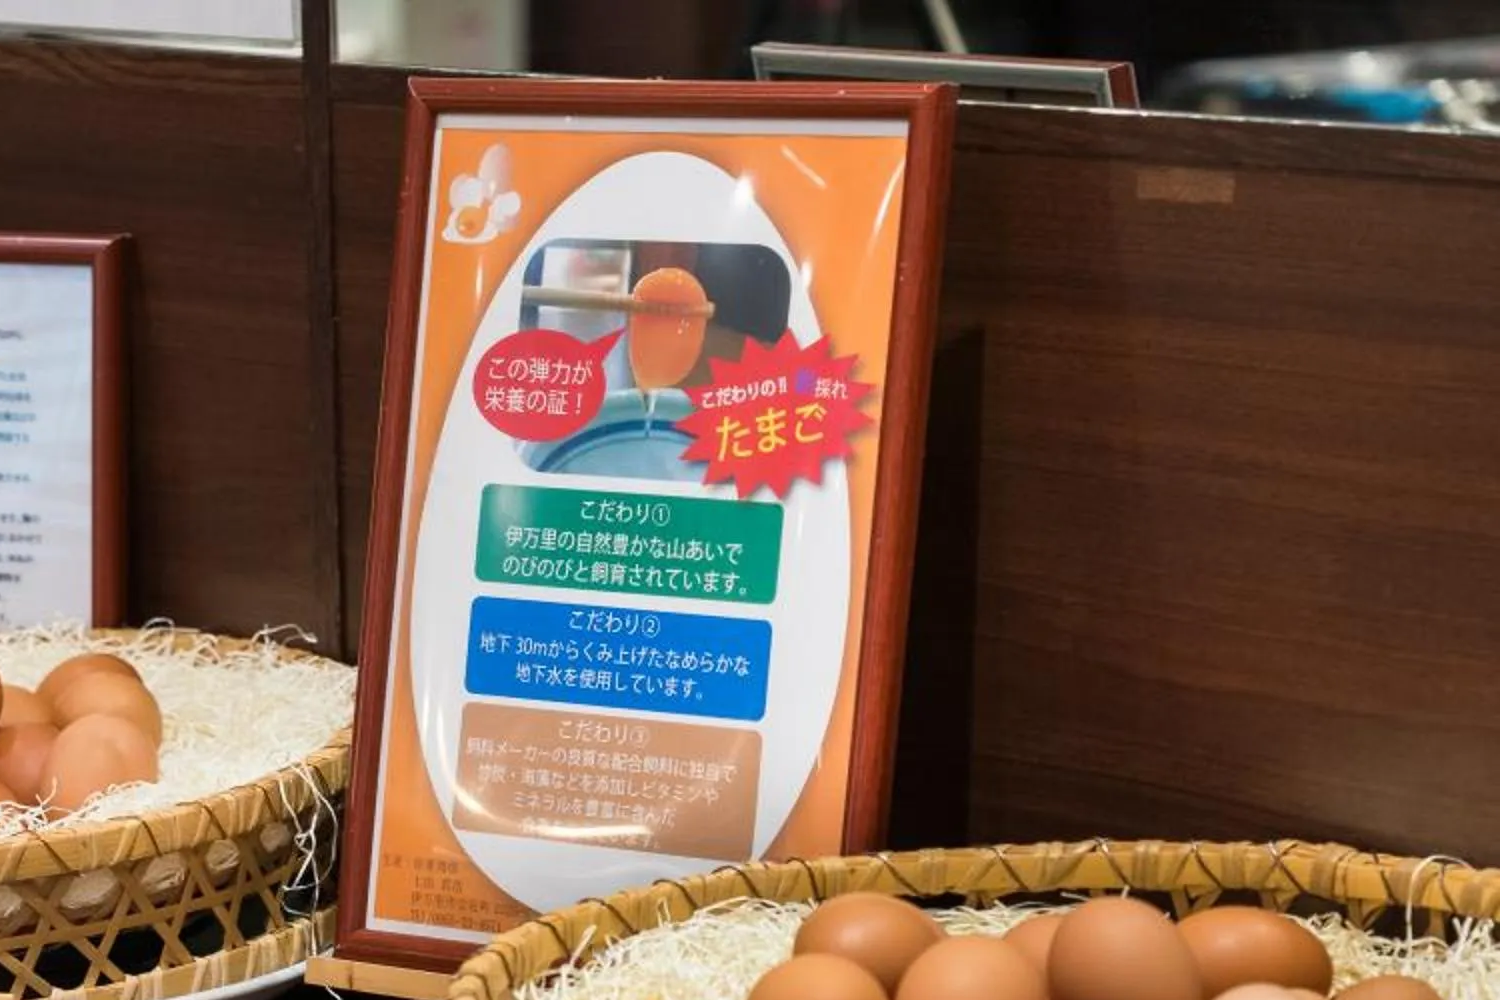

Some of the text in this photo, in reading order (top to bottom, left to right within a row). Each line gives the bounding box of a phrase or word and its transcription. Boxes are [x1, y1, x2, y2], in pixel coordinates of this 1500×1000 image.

[488, 357, 593, 385] この弾力が
[716, 402, 827, 461] たまご
[506, 526, 742, 565] 伊万里の自然豊かな山あいで
[503, 556, 747, 596] のびのびと飼育されています。
[515, 663, 703, 701] 地下水を使用しています。
